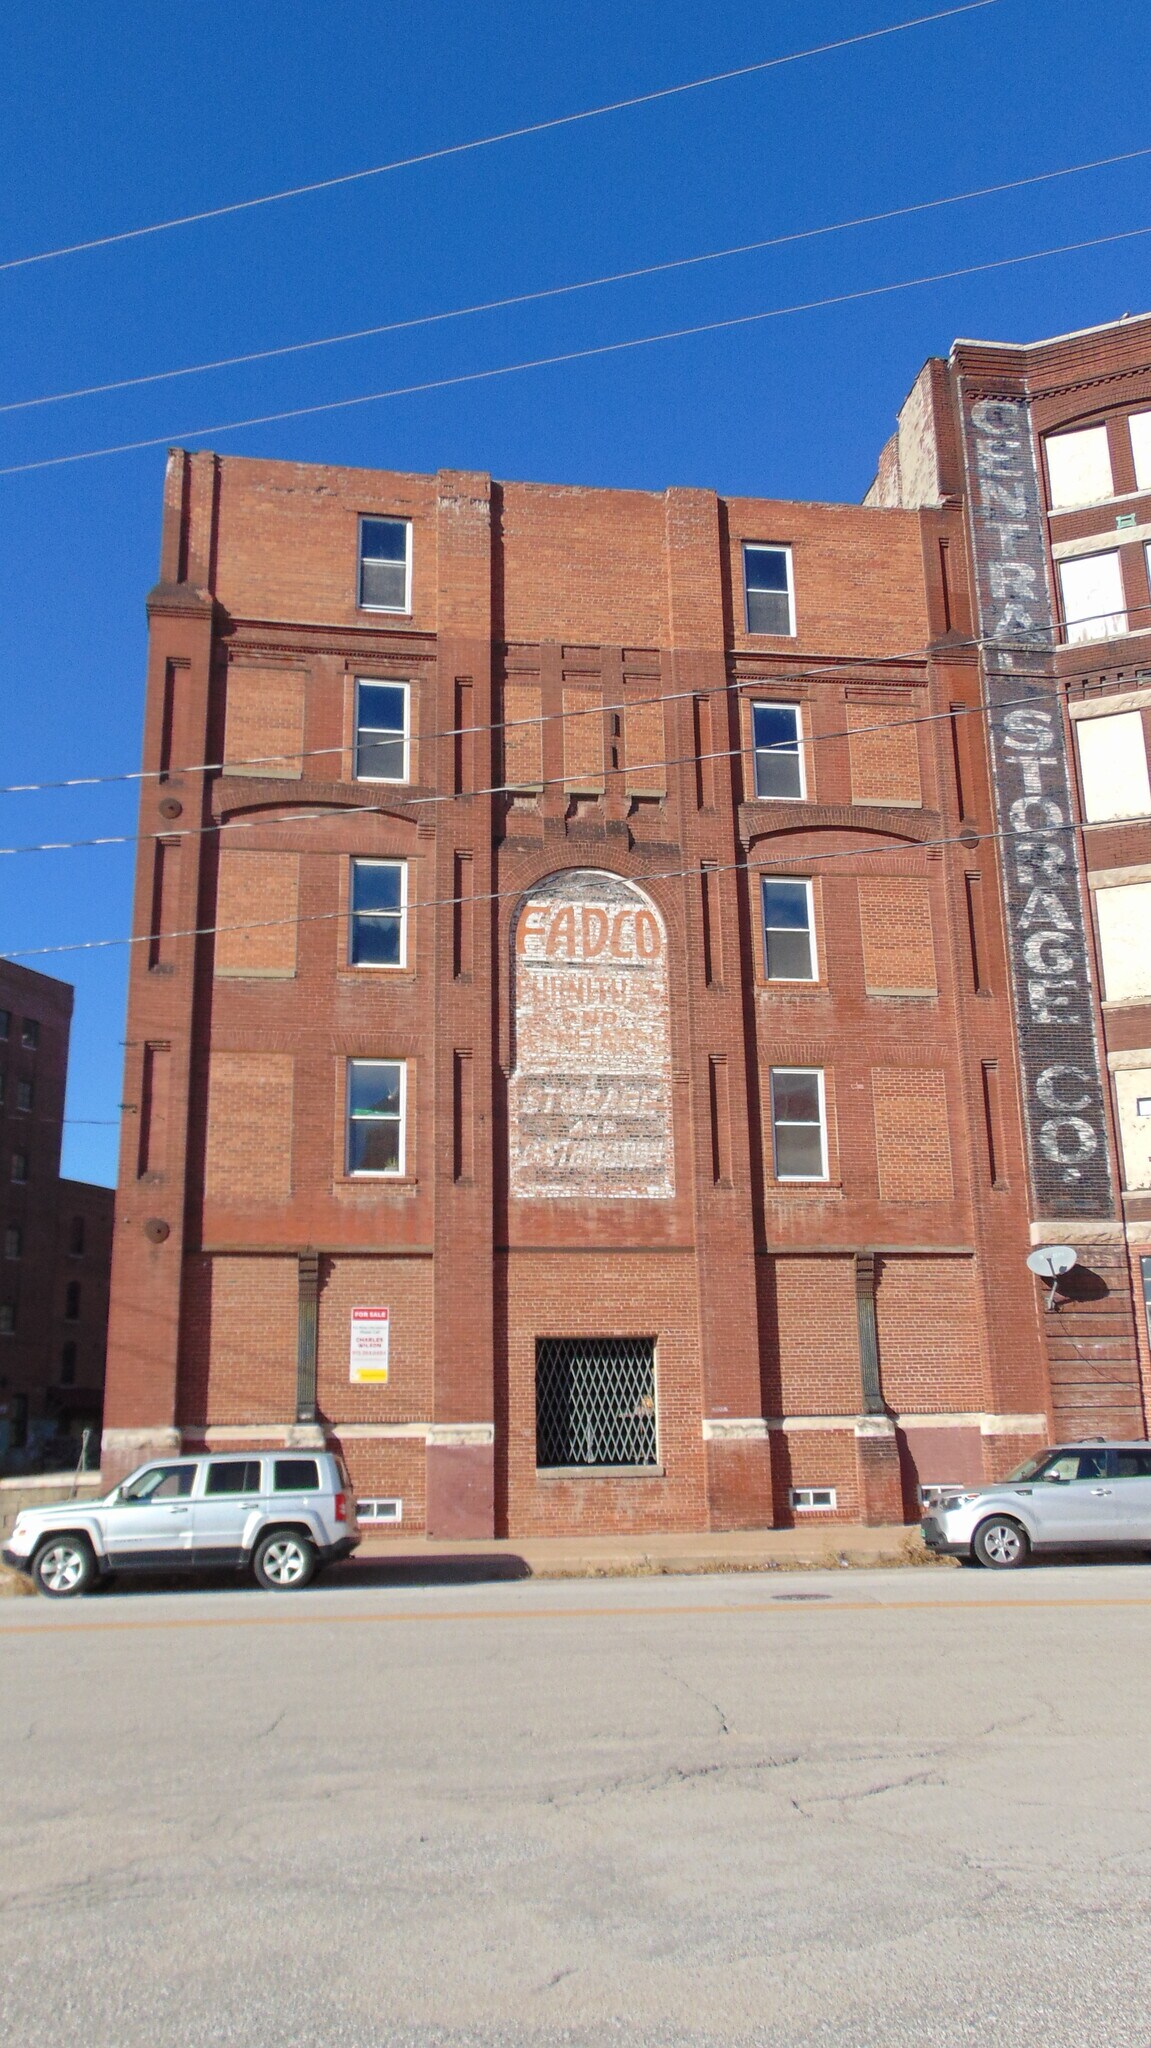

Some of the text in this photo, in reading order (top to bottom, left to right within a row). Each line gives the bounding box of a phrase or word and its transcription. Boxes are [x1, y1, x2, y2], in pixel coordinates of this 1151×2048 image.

[516, 905, 661, 958] FADCO
[970, 399, 1098, 1184] CENTRAL STORAGE CO.
